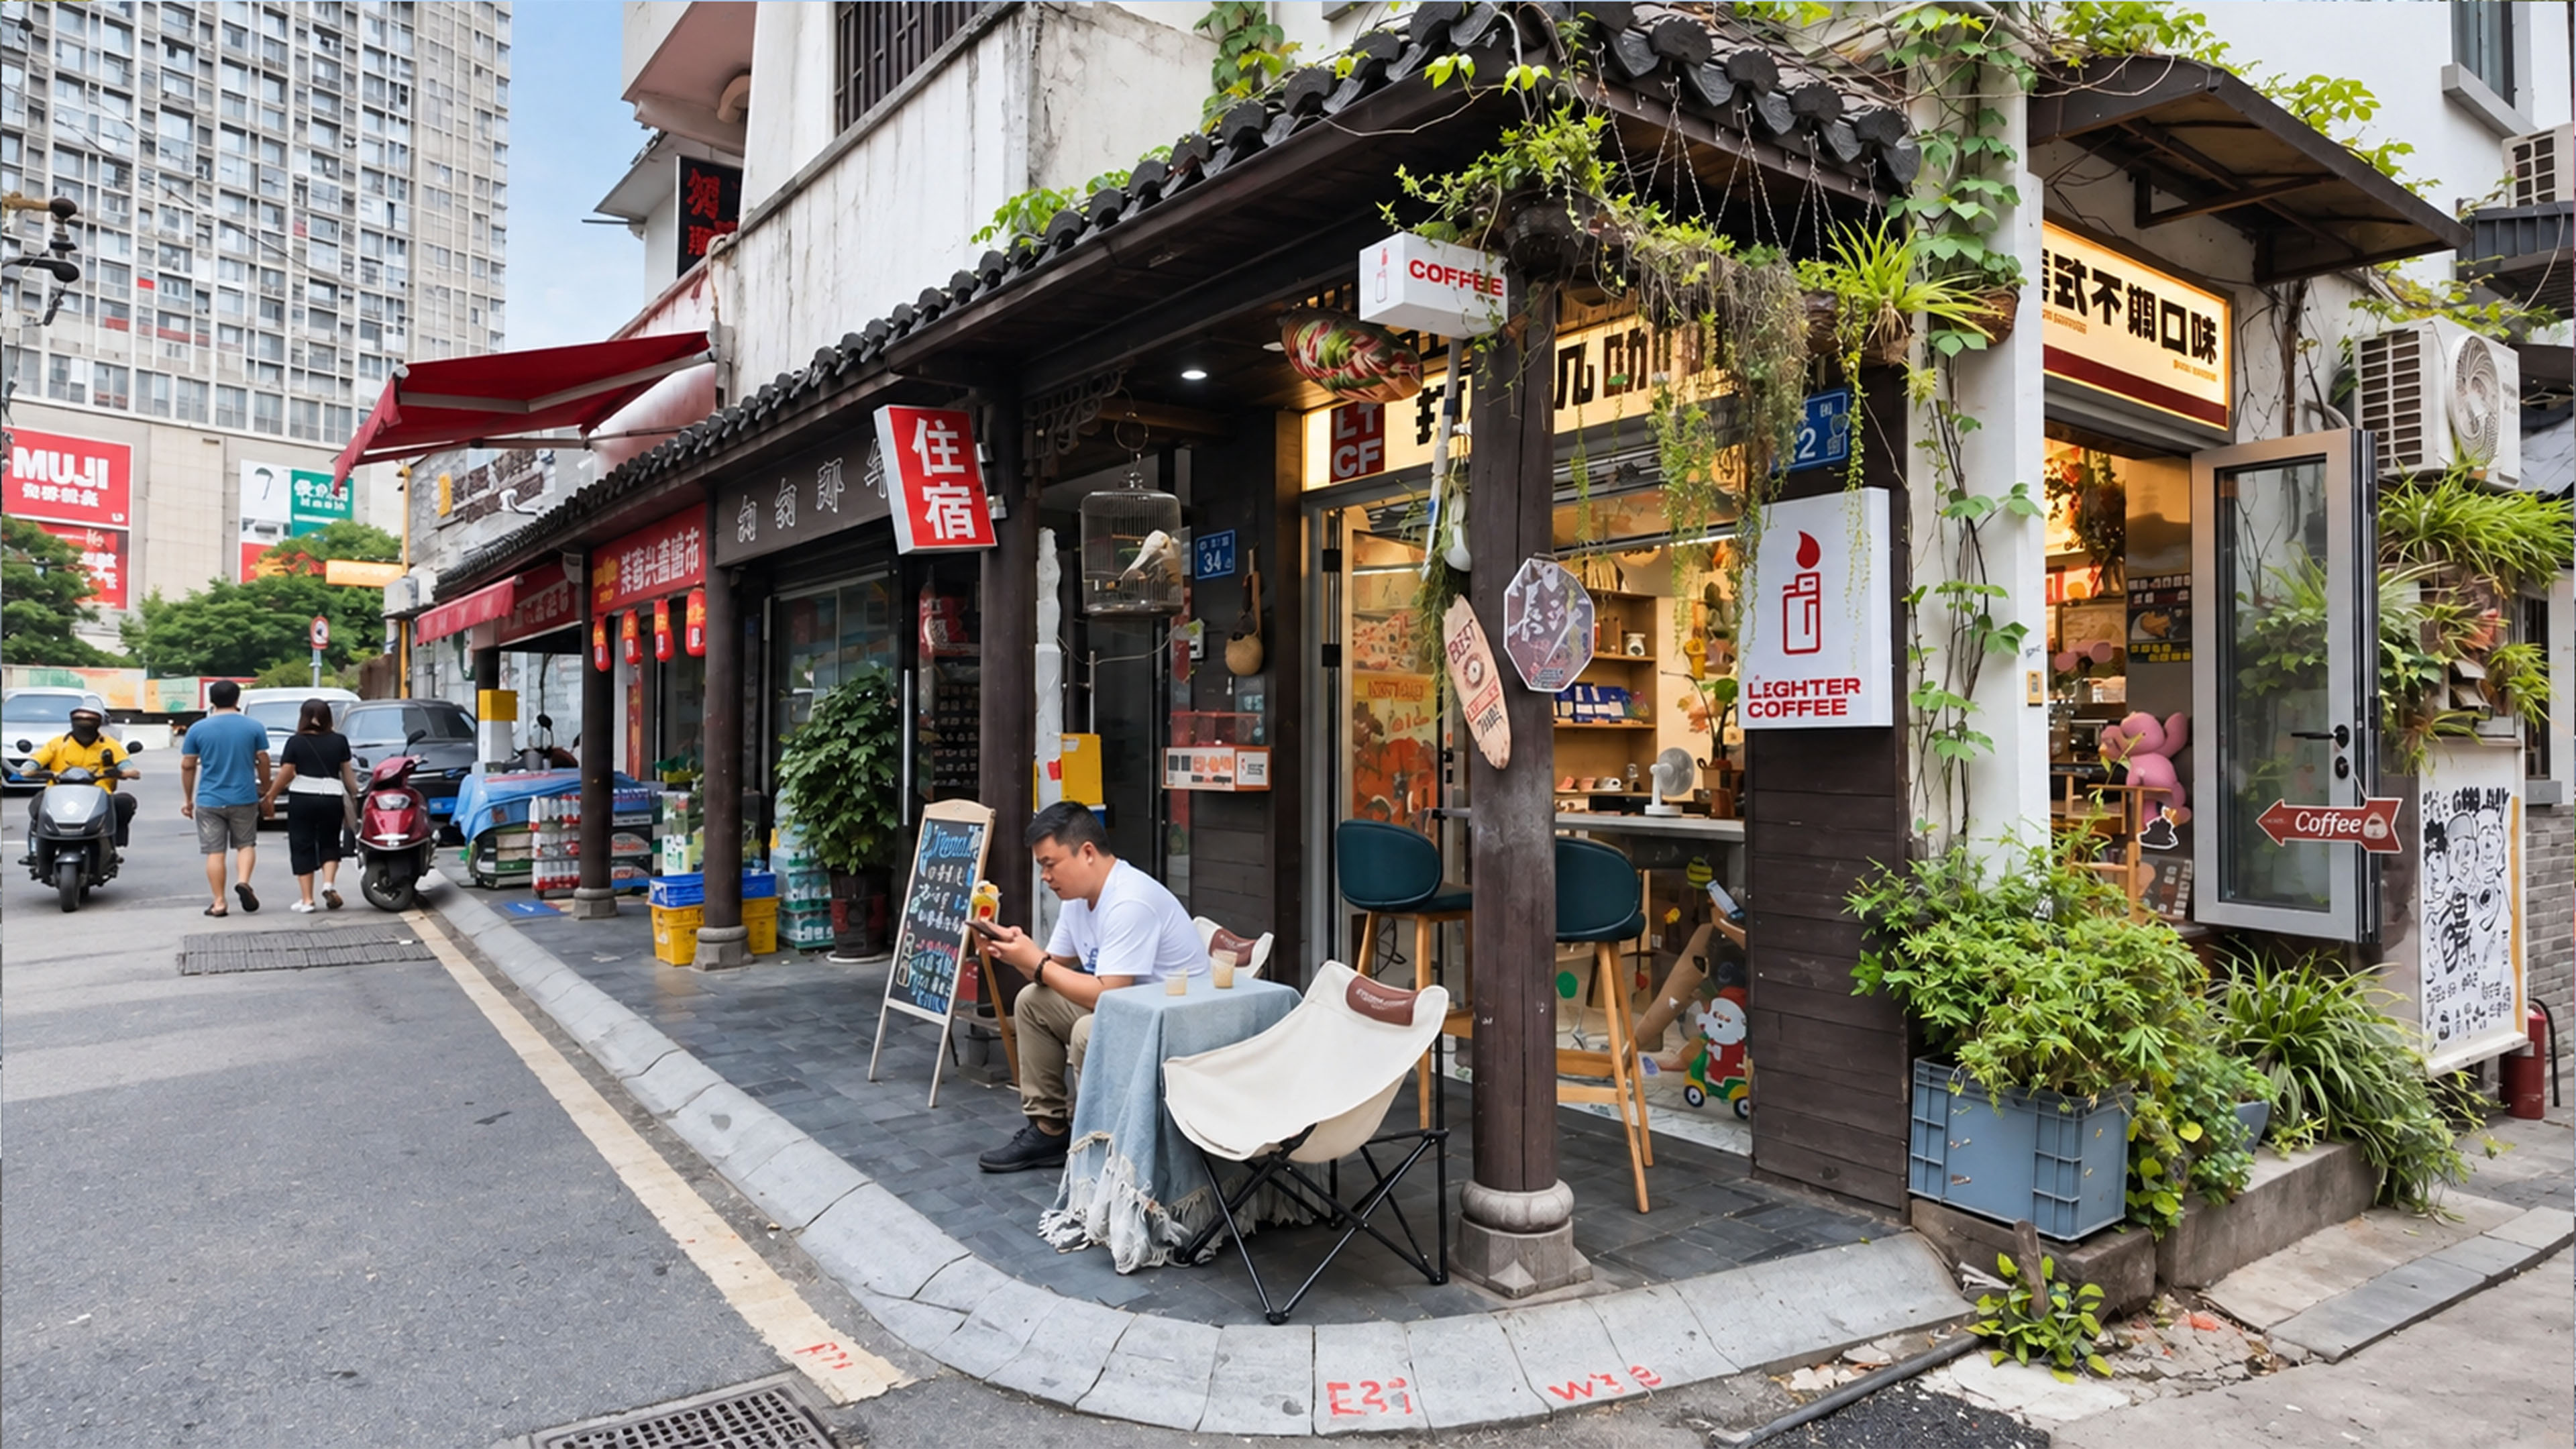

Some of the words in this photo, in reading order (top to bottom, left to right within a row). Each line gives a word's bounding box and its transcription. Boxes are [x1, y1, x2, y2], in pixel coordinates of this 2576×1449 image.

[1409, 259, 1503, 297] COFFEE
[13, 446, 109, 490] MUJI
[1333, 437, 1383, 478] CF
[911, 417, 977, 539] 住宿
[1204, 550, 1222, 573] 34
[1747, 698, 1847, 718] COFFEE
[2295, 810, 2362, 837] Coffee
